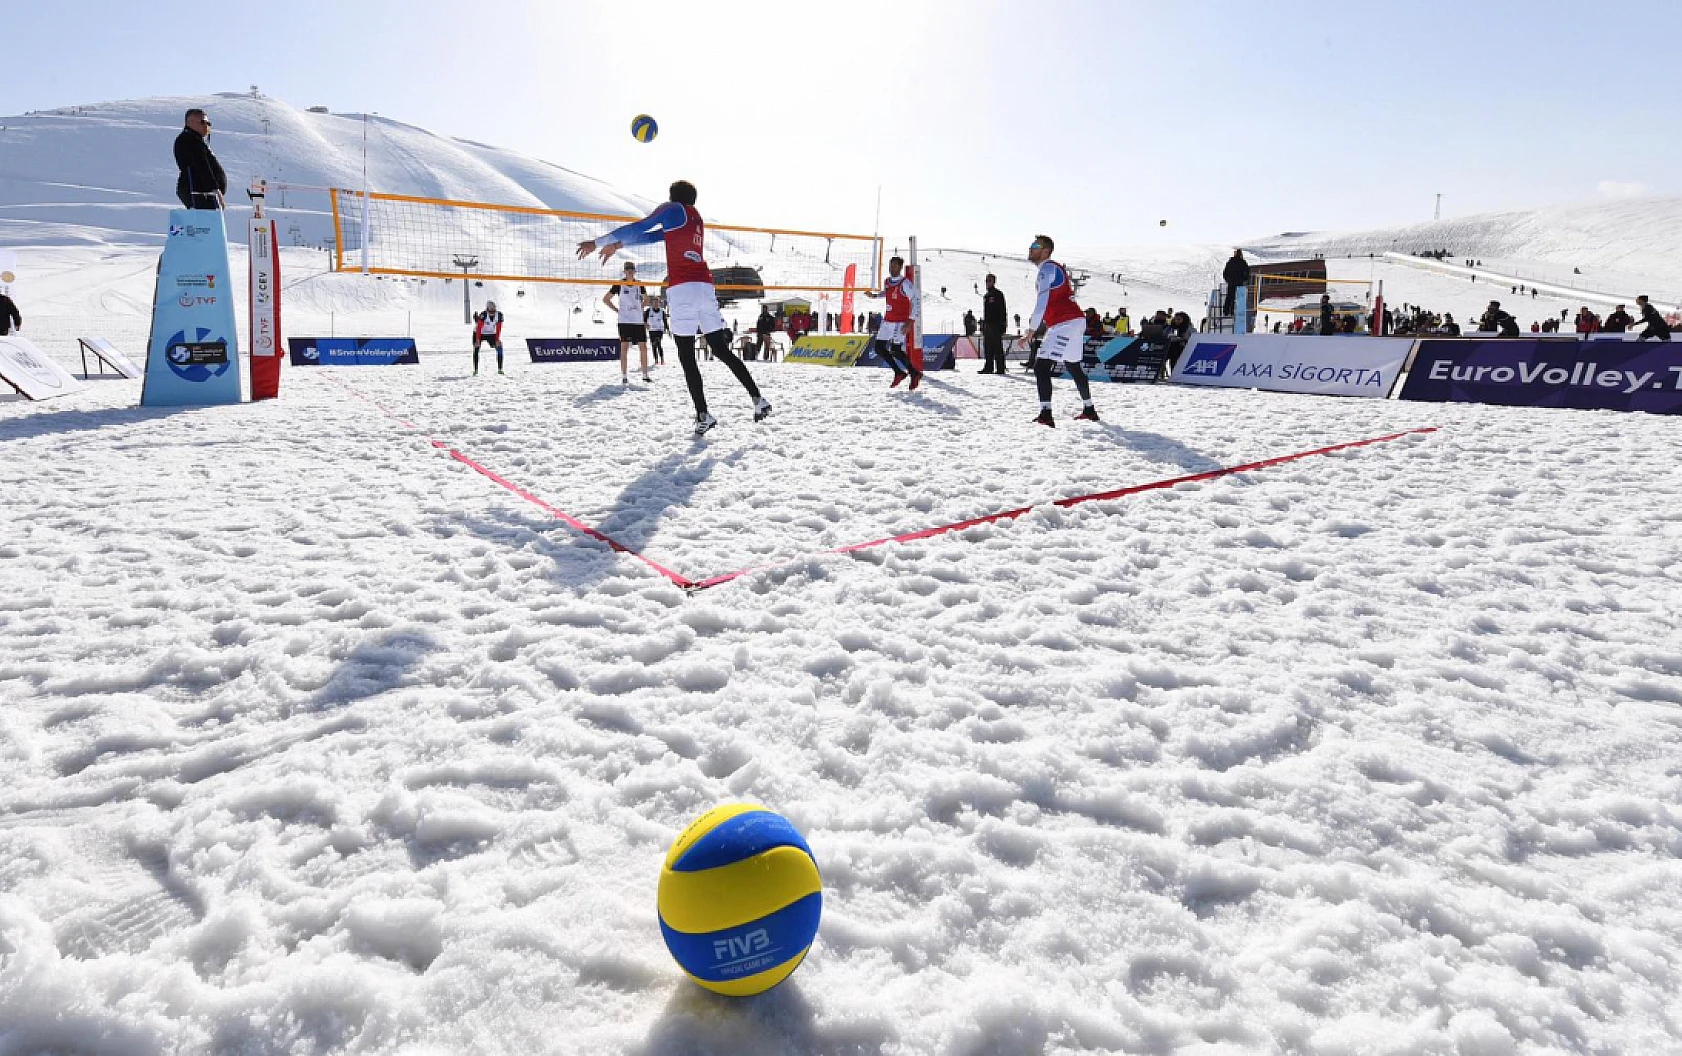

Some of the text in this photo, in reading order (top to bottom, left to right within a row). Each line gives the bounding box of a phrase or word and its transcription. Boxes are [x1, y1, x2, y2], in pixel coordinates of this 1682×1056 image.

[259, 271, 267, 290] CEV
[196, 296, 216, 304] TVF
[261, 317, 269, 334] TVF
[535, 345, 616, 356] EuroVolley.TV
[1185, 360, 1217, 374] AXA
[1232, 362, 1272, 377] AXA
[713, 928, 769, 960] FIVB
